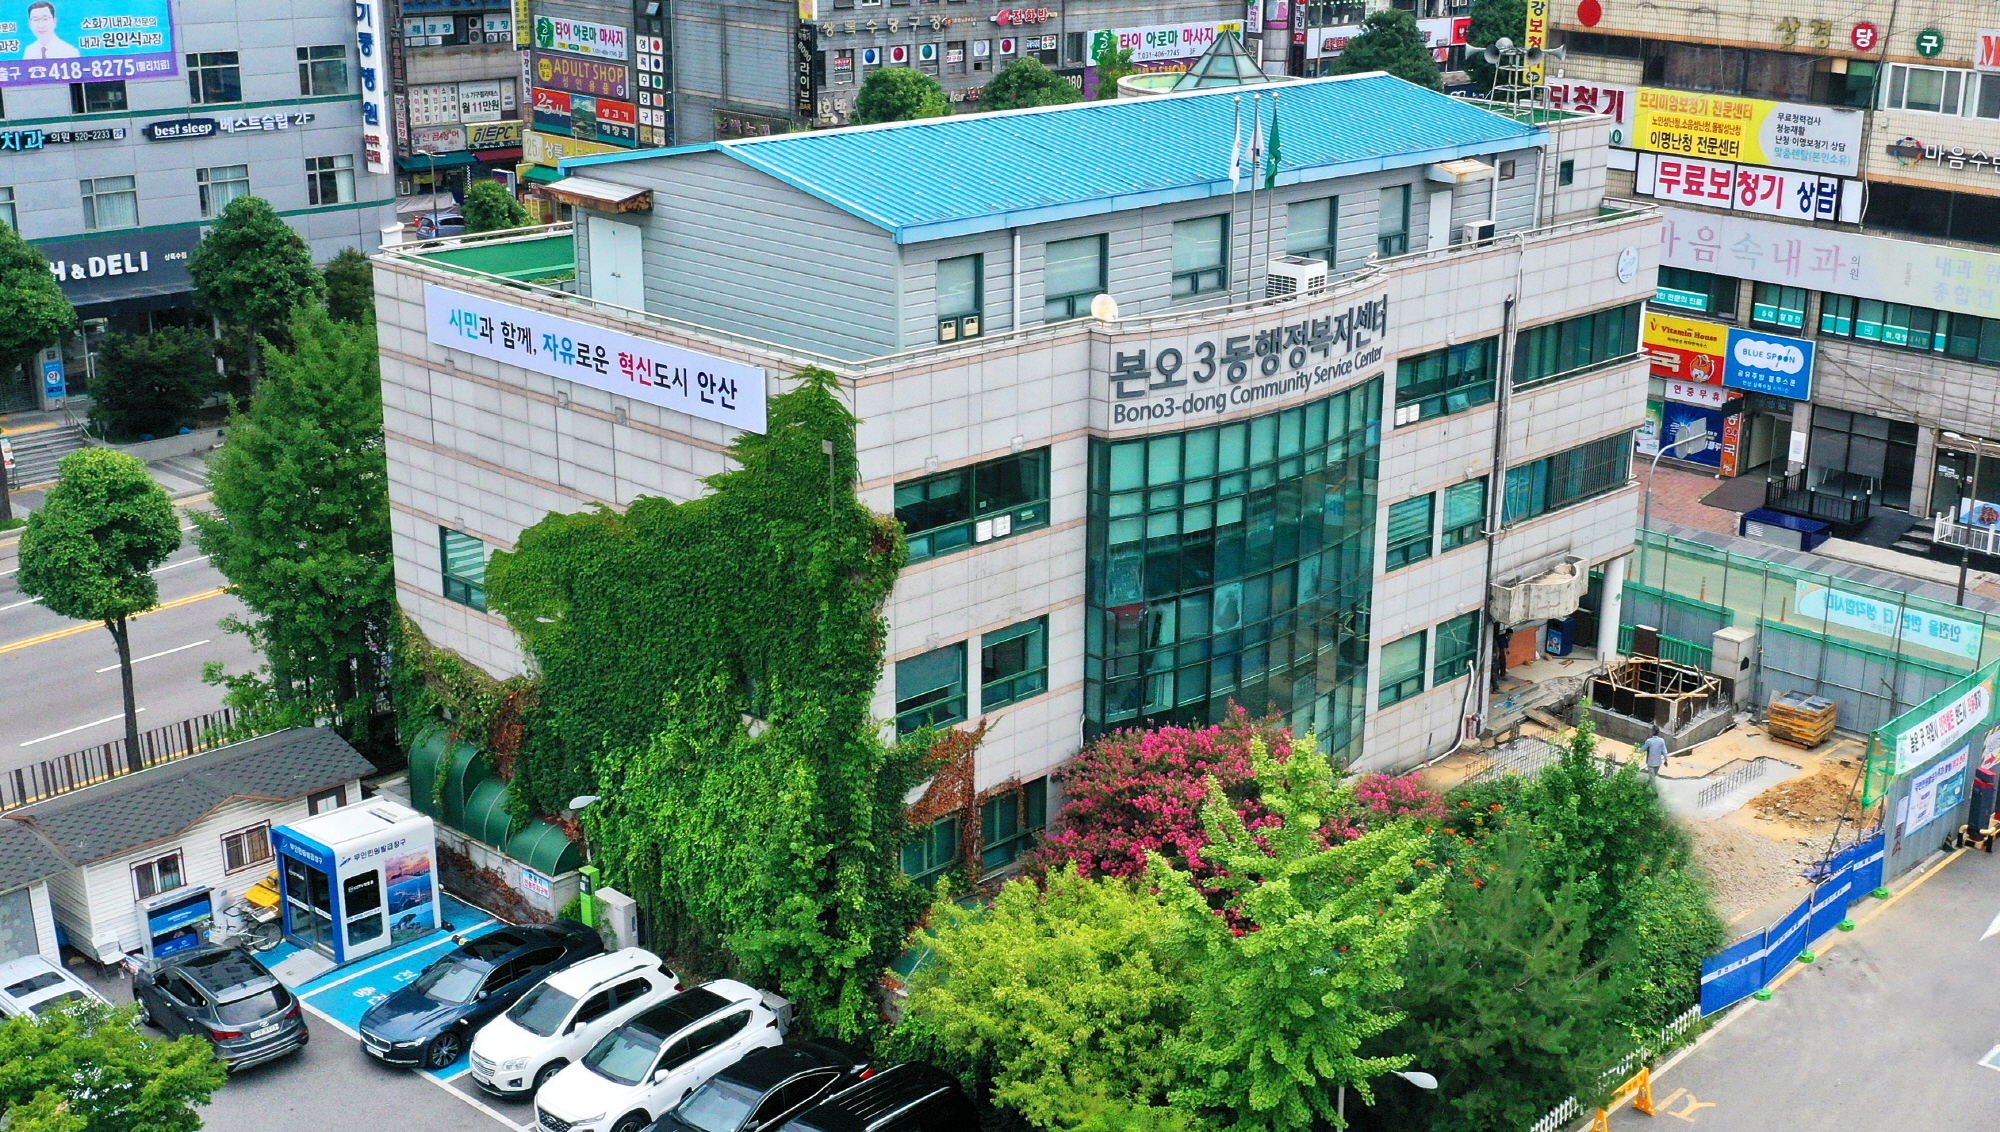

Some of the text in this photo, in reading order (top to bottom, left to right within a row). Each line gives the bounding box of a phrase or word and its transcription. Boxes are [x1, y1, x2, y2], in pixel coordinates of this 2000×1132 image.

[82, 16, 132, 29] 소화기내과
[1012, 7, 1048, 25] 전화방
[0, 22, 16, 33] 문의
[555, 21, 571, 40] 타이
[573, 24, 597, 44] 아로마
[599, 28, 624, 48] 마사지
[79, 36, 100, 48] 내과
[1119, 27, 1214, 50] 타이 아로마 마사지
[48, 59, 135, 80] 418-8275
[553, 58, 590, 79] ADULT
[592, 63, 624, 83] SHOP
[562, 76, 610, 94] 성인용품
[472, 99, 500, 113] 11만원
[1640, 92, 1754, 120] 프리미엄보청기 전문센터
[219, 112, 312, 134] 베스트슬립 2F
[655, 114, 663, 122] 3F
[1776, 112, 1822, 126] 무료청력검사
[154, 123, 213, 136] best sleep
[1776, 124, 1806, 136] 청능재활
[1, 130, 46, 150] 치과
[51, 132, 70, 143] 의원
[75, 130, 110, 141] 520-2233
[1650, 130, 1740, 158] 이명난청 전문센터
[1830, 141, 1846, 153] 상담
[1658, 161, 1837, 214] 무료보청기 상담
[88, 251, 149, 278] DELI
[1661, 325, 1718, 342] Vitamin House
[449, 308, 738, 411] 시민과 함께, 자유로운 혁신도시 안산
[1742, 347, 1796, 365] BLUE SPOON
[1114, 345, 1384, 425] Bono3-dong Community Service Center
